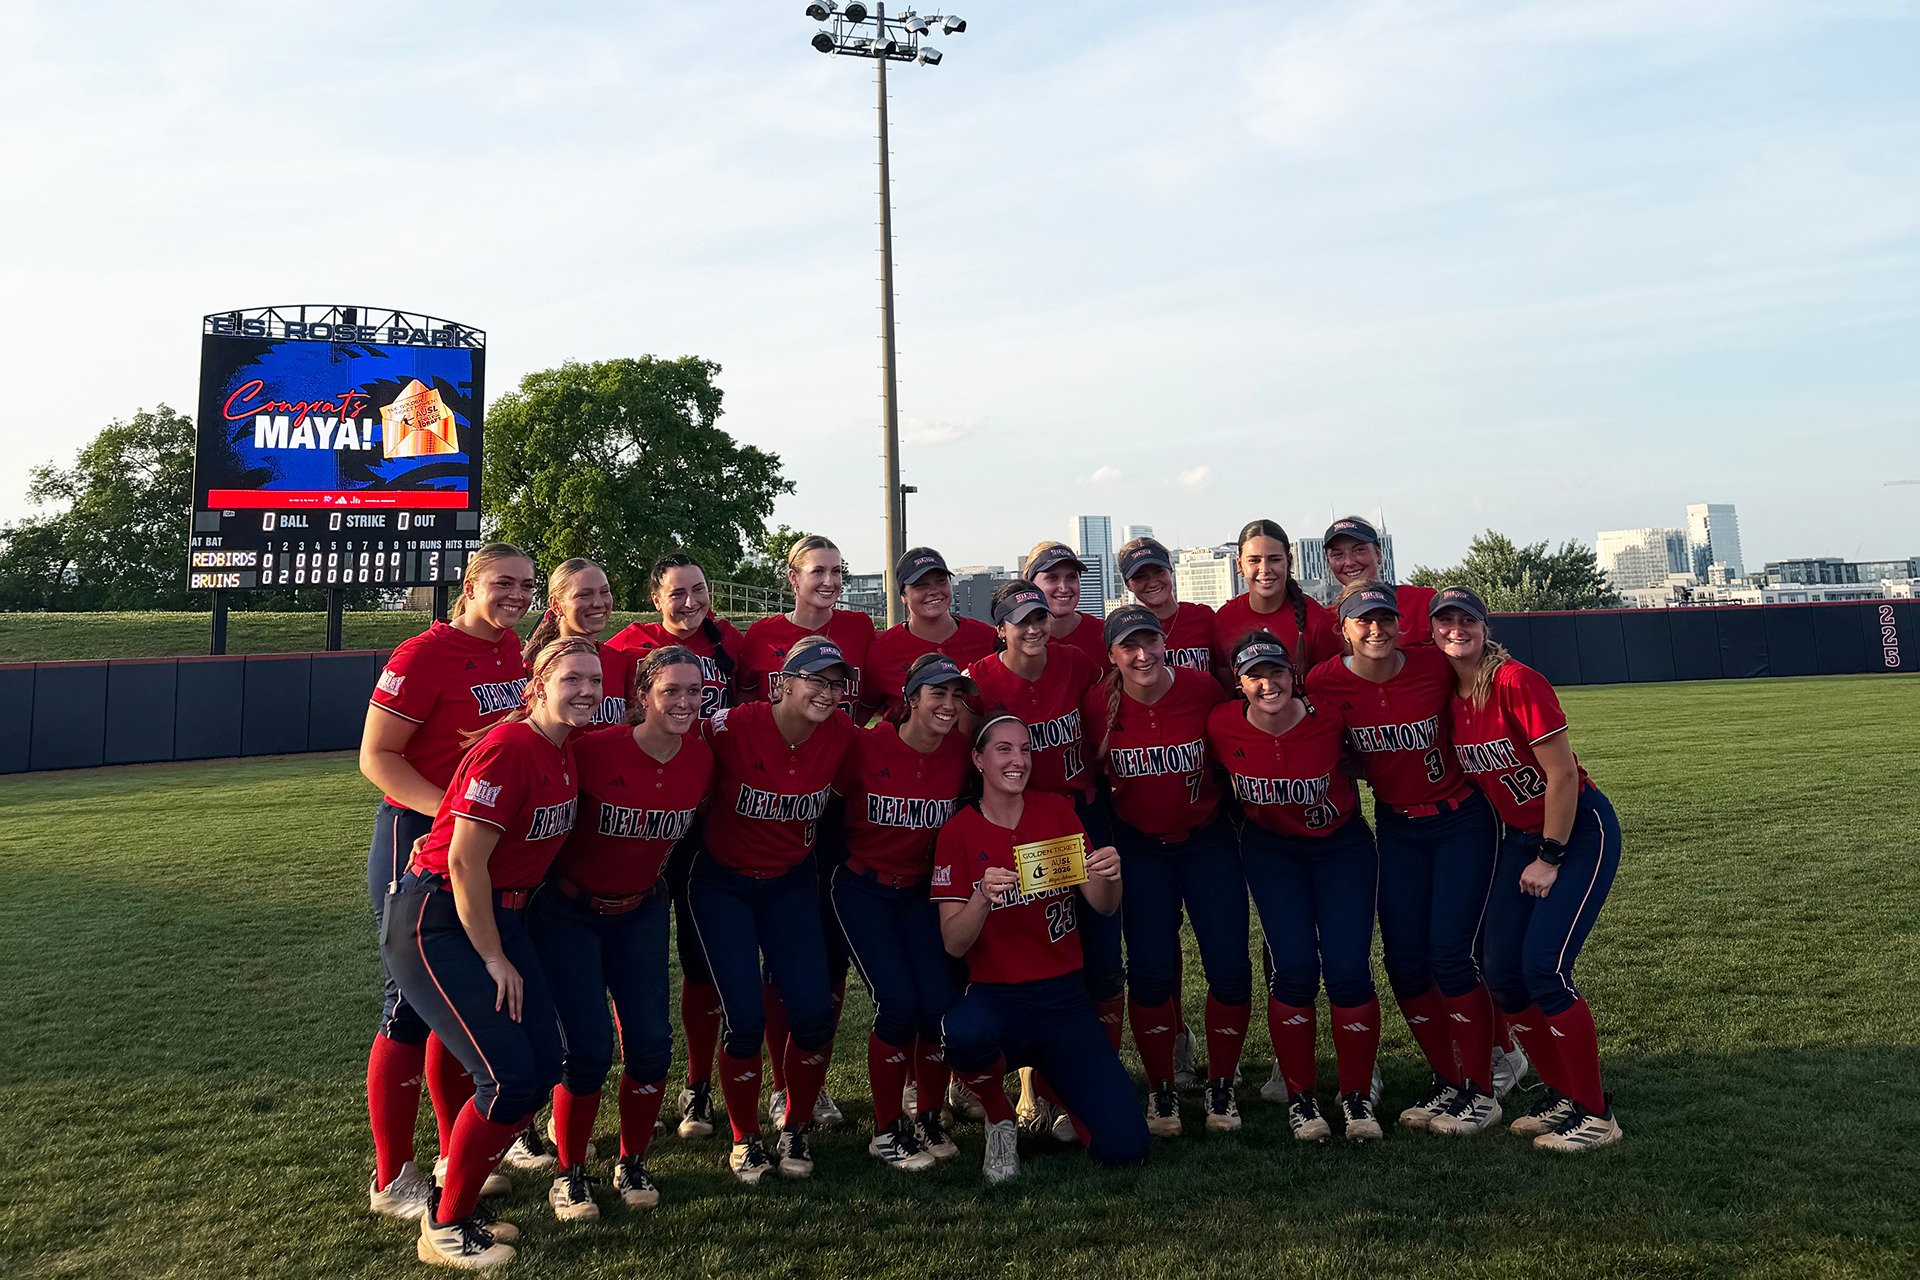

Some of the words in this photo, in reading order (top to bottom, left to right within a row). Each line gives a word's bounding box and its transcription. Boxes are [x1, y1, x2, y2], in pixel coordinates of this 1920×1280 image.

[212, 316, 273, 338] E.S.
[284, 320, 377, 343] ROSE
[387, 326, 477, 347] PARK
[222, 379, 371, 428] Congrats
[416, 405, 438, 417] AUSL
[254, 414, 373, 451] MAYA!
[262, 512, 276, 531] 0
[280, 515, 309, 528] BALL
[329, 512, 342, 531] 0
[346, 514, 386, 528] STRIKE
[397, 512, 410, 531] 0
[414, 514, 436, 527] OUT
[191, 537, 202, 547] AT
[205, 537, 223, 547] BAT
[267, 541, 272, 551] 1
[282, 541, 289, 551] 2
[299, 541, 305, 551] 3
[315, 541, 320, 551] 4
[331, 541, 337, 550] 5
[346, 541, 352, 550] 6
[362, 541, 368, 550] 7
[378, 540, 384, 550] 8
[393, 540, 399, 550] 9
[407, 540, 417, 550] 10
[420, 540, 442, 550] RUNS
[445, 540, 463, 549] HITS
[192, 551, 257, 567] REDBIRDS
[263, 553, 273, 568] 0
[296, 553, 306, 568] 0
[312, 553, 322, 568] 0
[328, 553, 338, 568] 0
[360, 552, 370, 566] 0
[375, 552, 385, 566] 0
[391, 552, 400, 566] 0
[429, 551, 439, 565] 2
[191, 573, 240, 588] BRUINS
[262, 570, 272, 584] 0
[279, 570, 288, 584] 2
[295, 570, 305, 584] 0
[311, 569, 321, 584] 0
[327, 569, 337, 583] 0
[343, 569, 353, 583] 0
[359, 569, 369, 583] 0
[375, 568, 384, 582] 0
[395, 568, 400, 581] 1
[429, 567, 438, 581] 3
[454, 567, 461, 580] 7
[1879, 605, 1900, 667] 225
[1163, 648, 1209, 672] MONT
[1027, 708, 1081, 752] MONT
[1111, 739, 1204, 778] BELMONT
[1424, 747, 1445, 783] 3
[1454, 737, 1521, 774] LMONT
[1186, 770, 1204, 803] 7
[1235, 772, 1330, 805] BELMONT
[1499, 765, 1547, 805] 12
[1022, 849, 1053, 860] GOLDEN
[1053, 843, 1077, 853] TICKET
[1051, 856, 1071, 867] AUSL
[1052, 865, 1071, 875] 2026
[1045, 893, 1077, 942] 23
